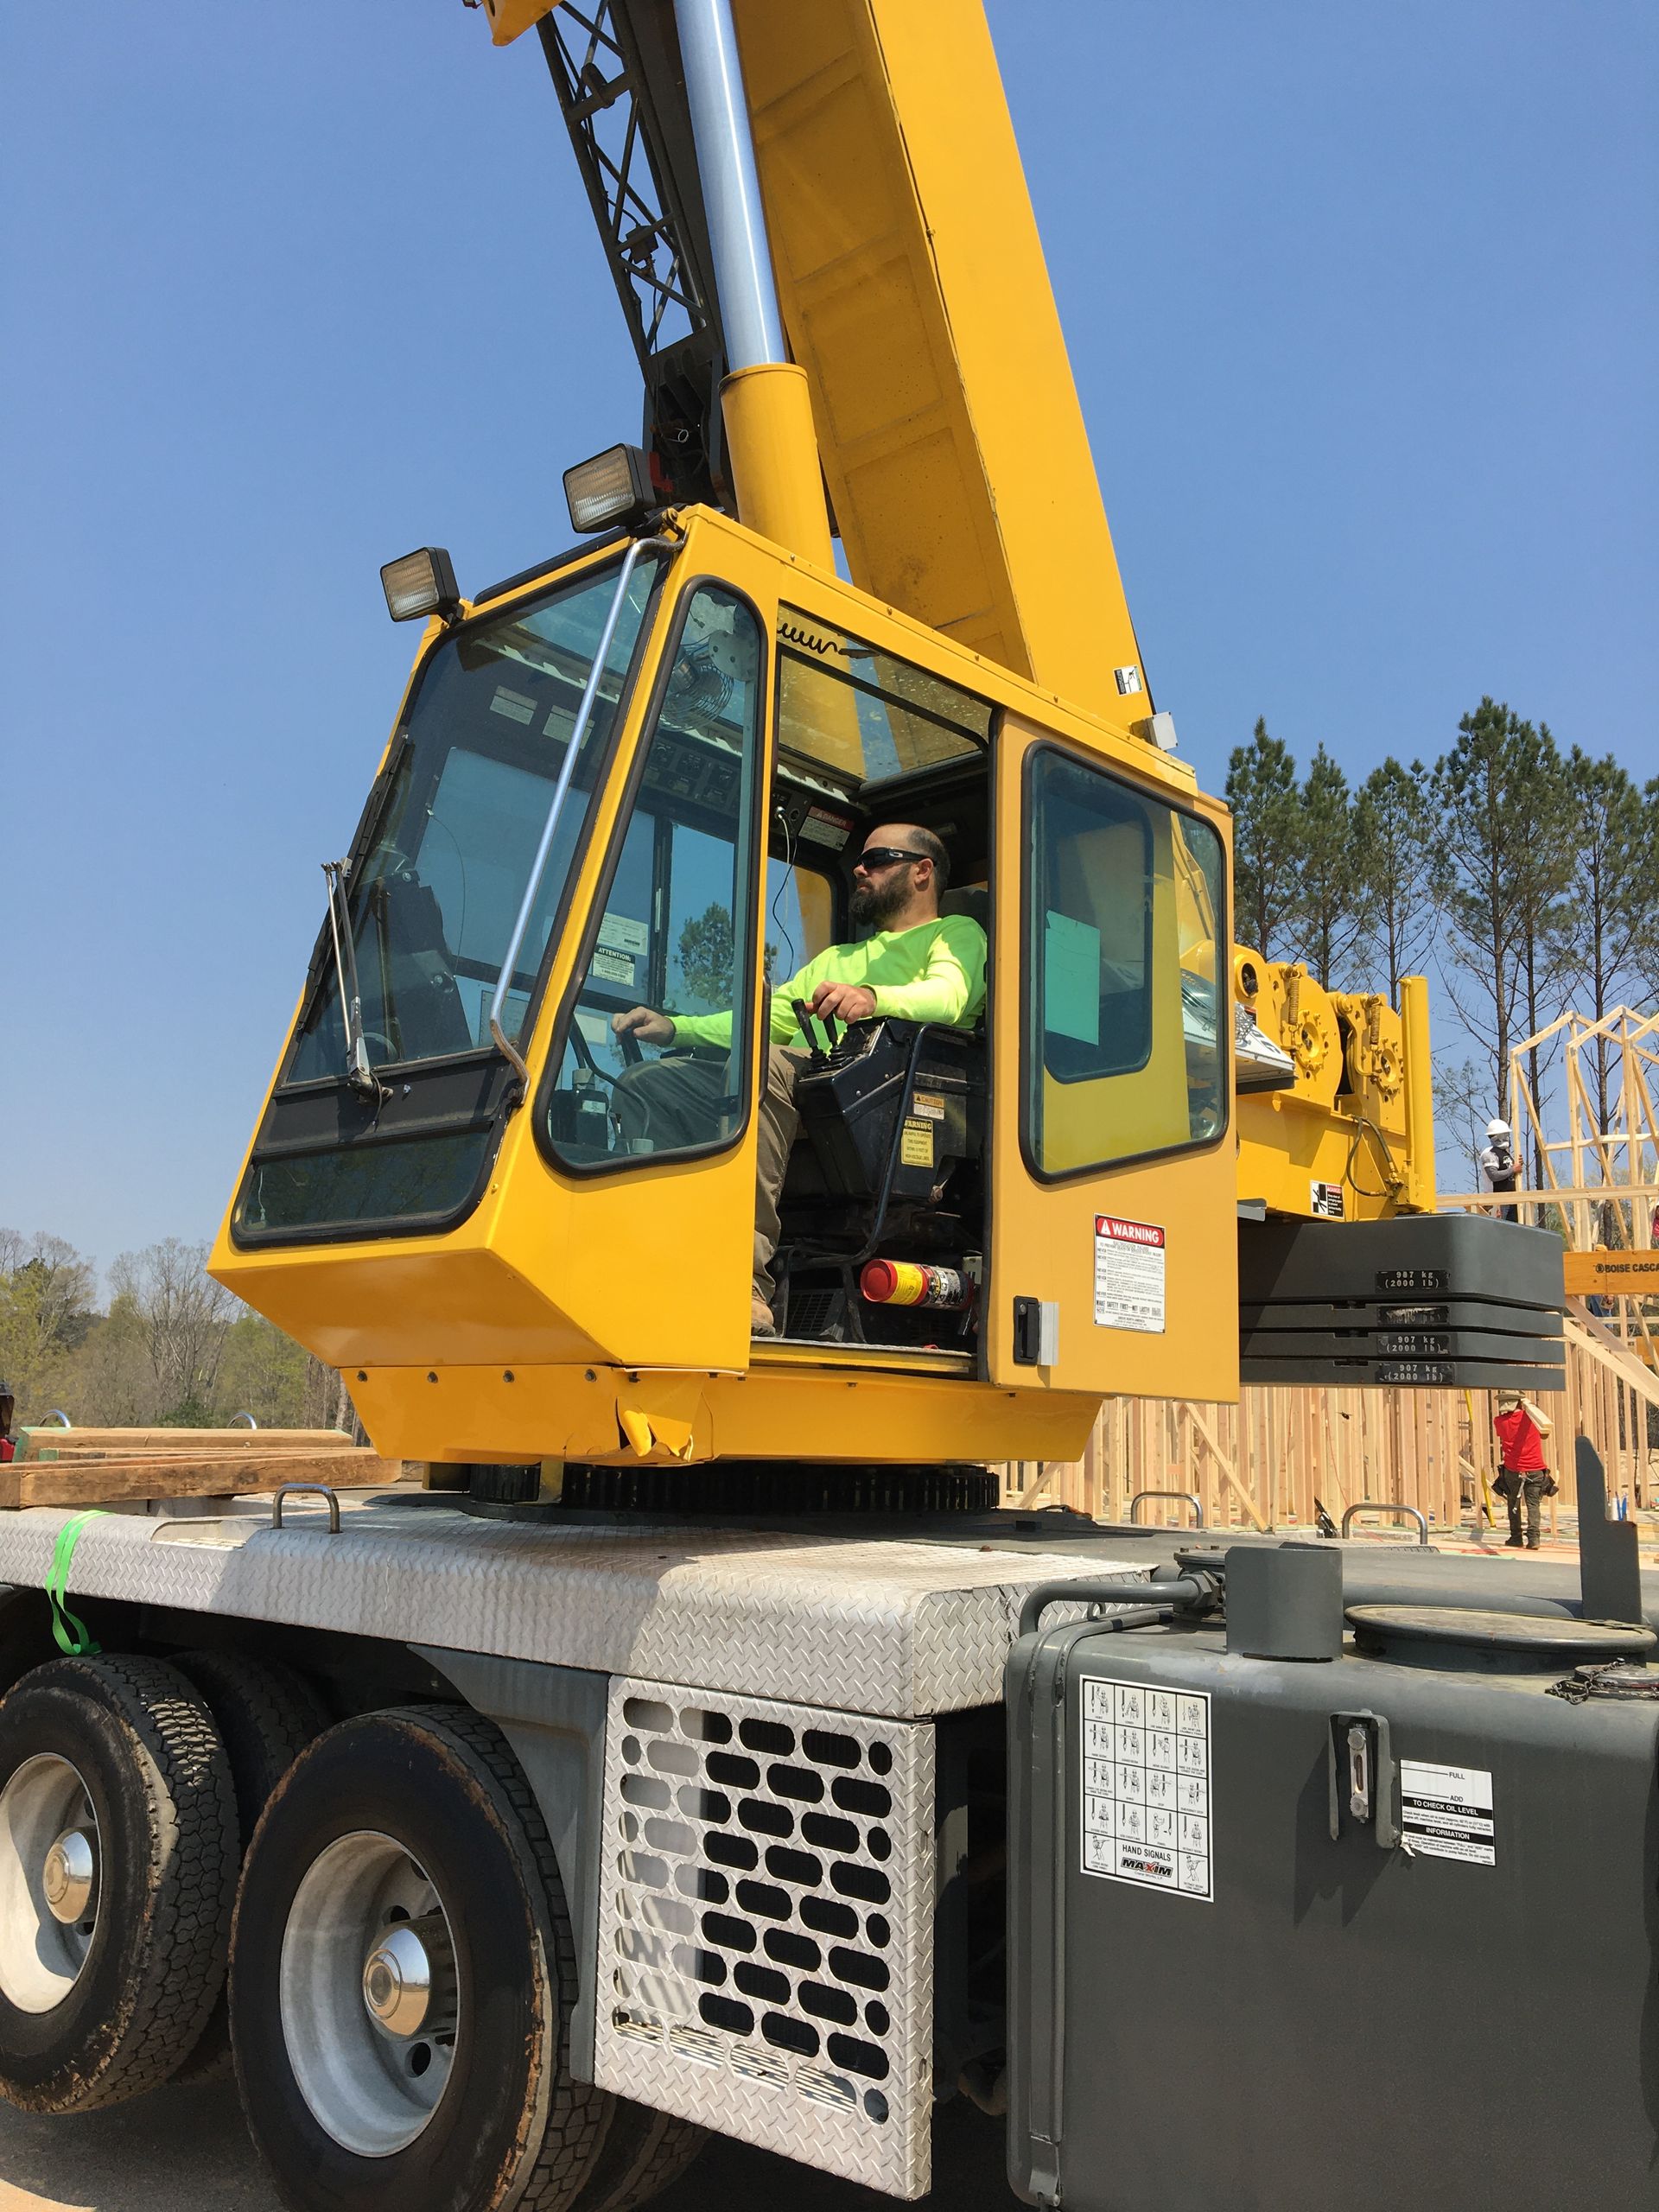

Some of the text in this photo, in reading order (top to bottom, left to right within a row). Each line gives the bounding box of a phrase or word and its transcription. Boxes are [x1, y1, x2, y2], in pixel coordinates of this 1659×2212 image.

[598, 947, 631, 962] ATTENTION:
[1112, 1222, 1160, 1243] WARNING
[1605, 1264, 1630, 1273] BOISE
[1385, 1279, 1439, 1288] (2000 lb)
[1387, 1344, 1440, 1352] (2000 lb)
[1389, 1372, 1443, 1382] (2000 lb)
[1449, 1771, 1465, 1780] FULL
[1422, 1801, 1446, 1810] CHECK
[1446, 1804, 1457, 1813] OIL
[1458, 1807, 1479, 1815] LEVEL
[1426, 1827, 1471, 1840] INFORMATION
[1122, 1844, 1142, 1855] HAND
[1143, 1847, 1172, 1862] SIGNALS
[1122, 1859, 1173, 1876] MAXIM
